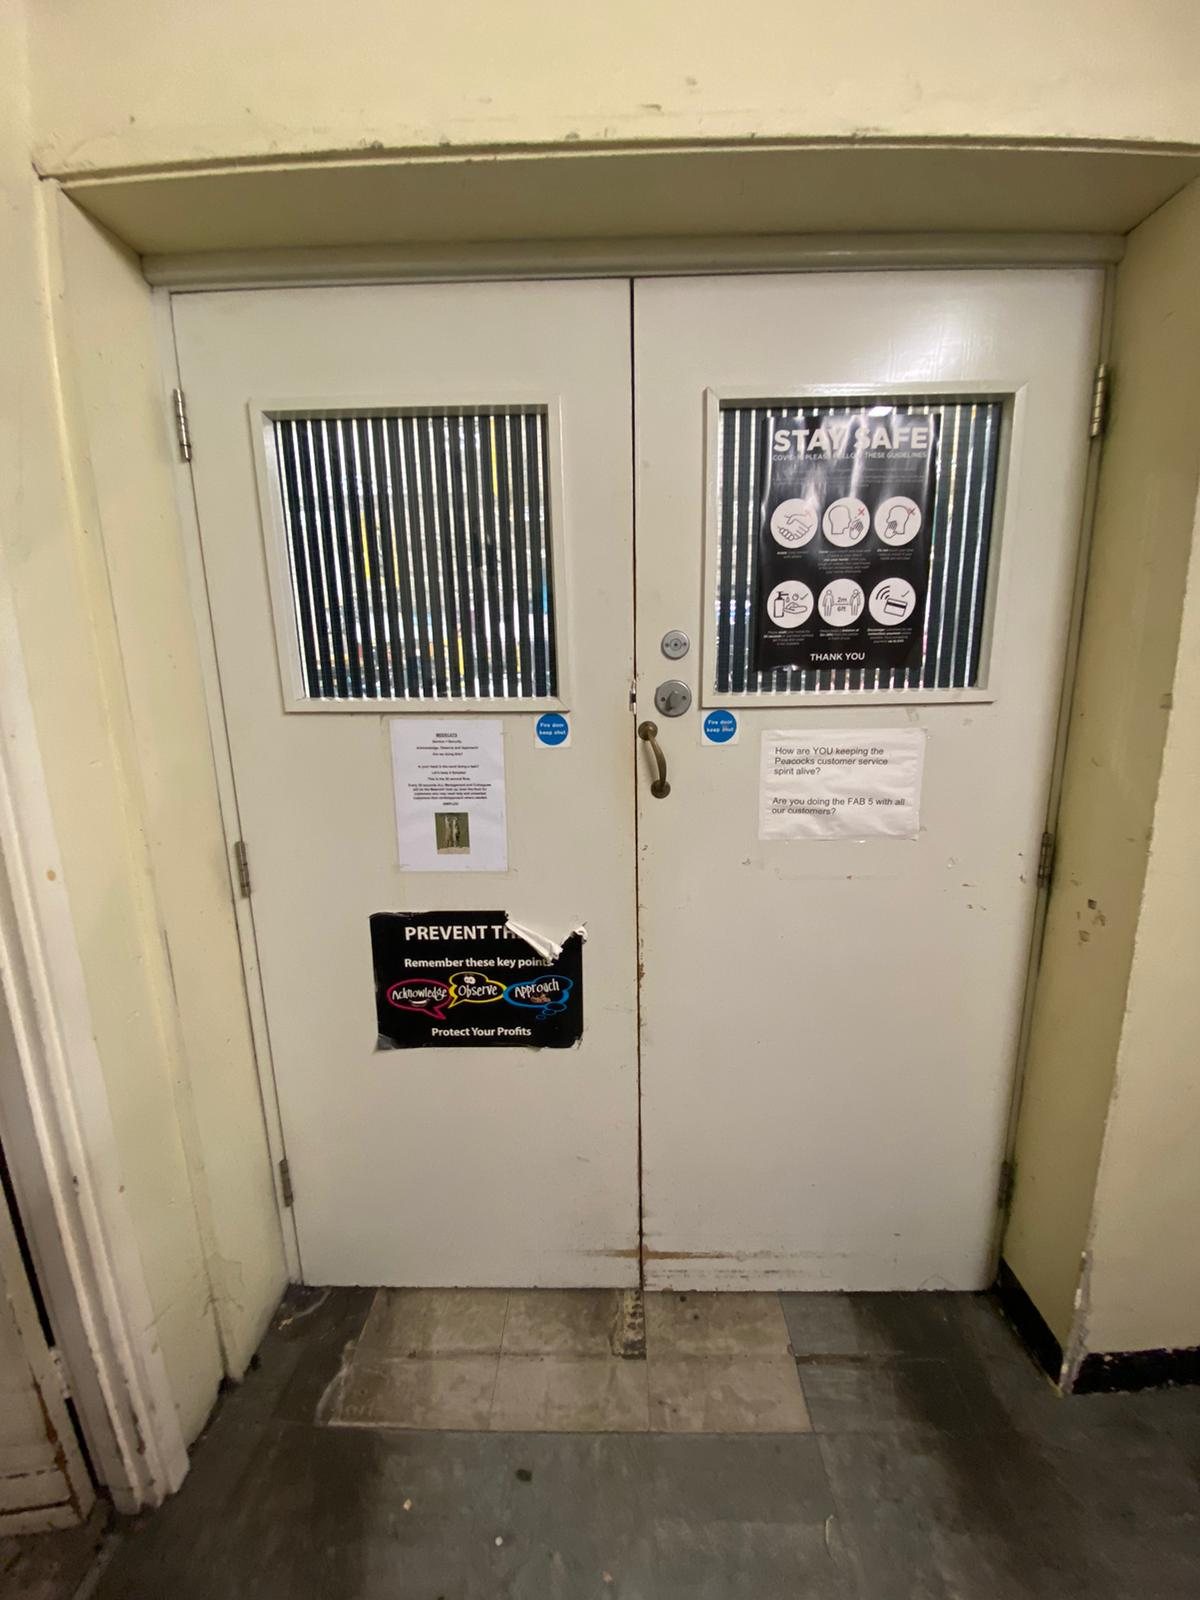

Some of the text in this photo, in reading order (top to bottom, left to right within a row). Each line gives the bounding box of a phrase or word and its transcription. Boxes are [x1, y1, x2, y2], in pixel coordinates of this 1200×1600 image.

[773, 426, 929, 452] STAY SAFE
[810, 652, 866, 662] THANK YOU
[774, 747, 793, 755] How
[813, 747, 833, 755] YOU
[835, 747, 868, 757] keeping
[871, 747, 884, 755] the
[774, 757, 888, 766] Peacocks customer service
[774, 766, 821, 776] spirit alive?
[772, 797, 906, 807] Are you doing the FAB 5 with all
[787, 807, 836, 815] customers?
[405, 925, 488, 940] PREVENT
[404, 958, 464, 968] Remember
[465, 957, 495, 968] these
[497, 957, 516, 969] key
[458, 985, 498, 998] Observe
[514, 978, 560, 996] Approach
[392, 988, 448, 1001] Acknowledge
[431, 1027, 532, 1037] Protect Your Profits
